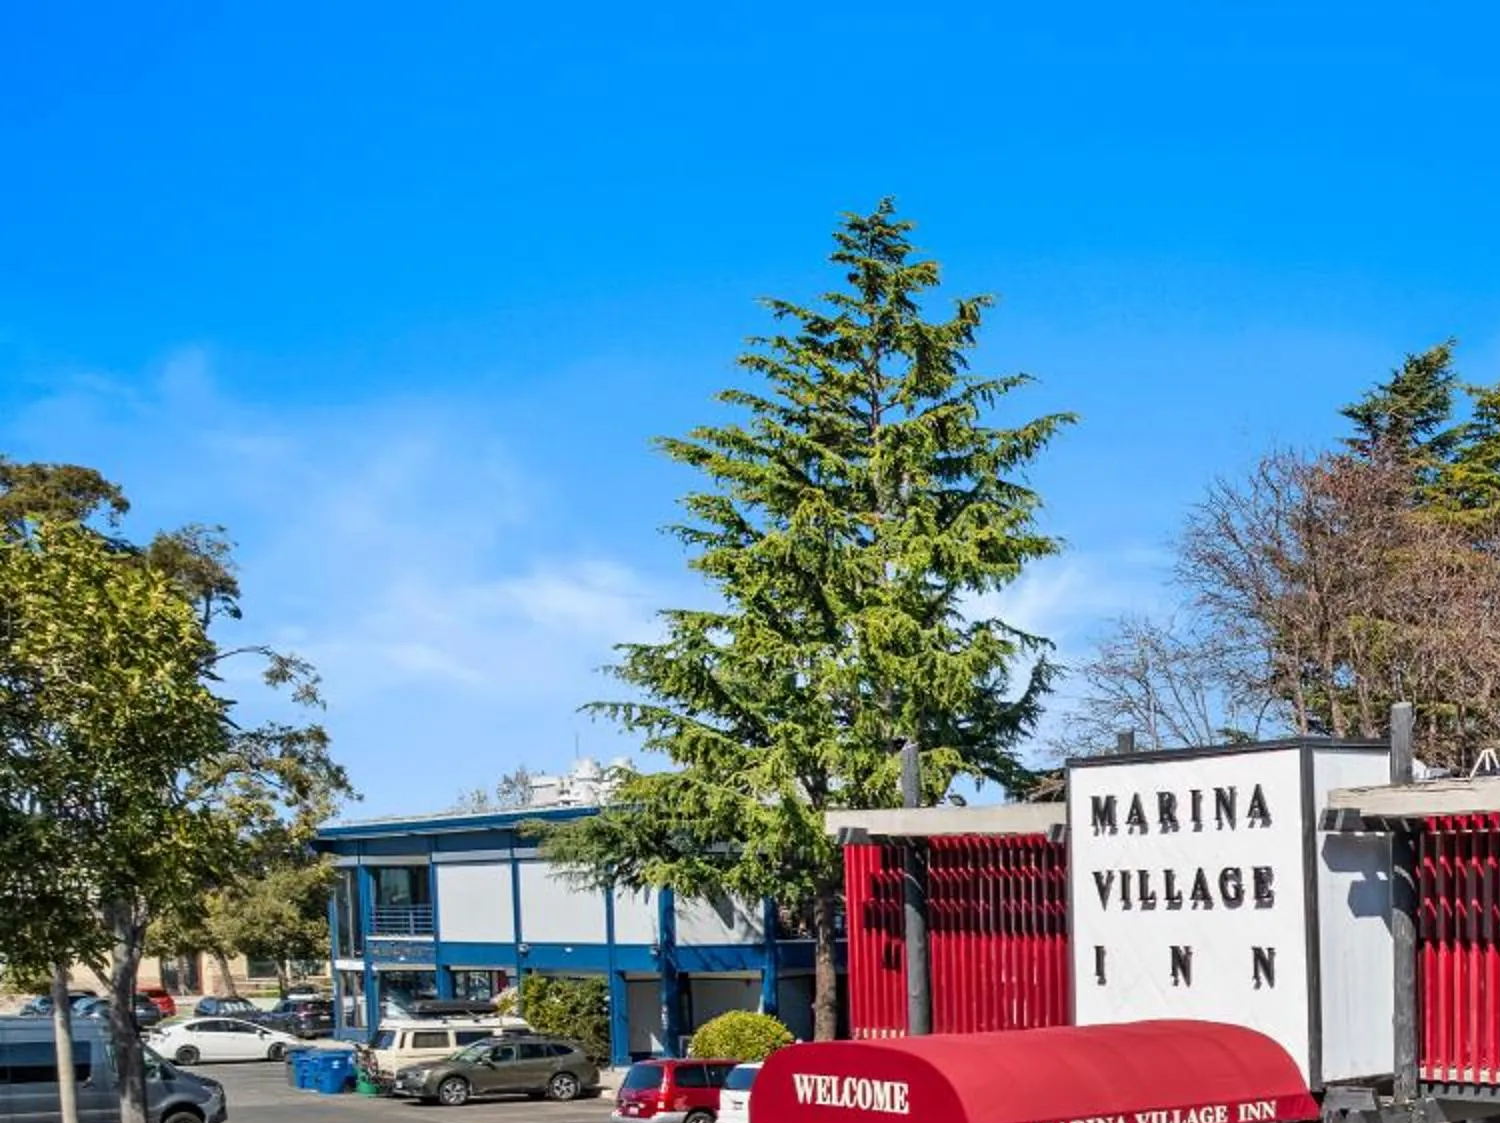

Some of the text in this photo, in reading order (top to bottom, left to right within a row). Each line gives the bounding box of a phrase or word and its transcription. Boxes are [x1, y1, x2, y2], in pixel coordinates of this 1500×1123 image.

[1090, 783, 1273, 836] MARINA
[1092, 866, 1275, 911] VILLAGE
[792, 1073, 910, 1115] WELCOME
[1238, 1100, 1277, 1122] INN
